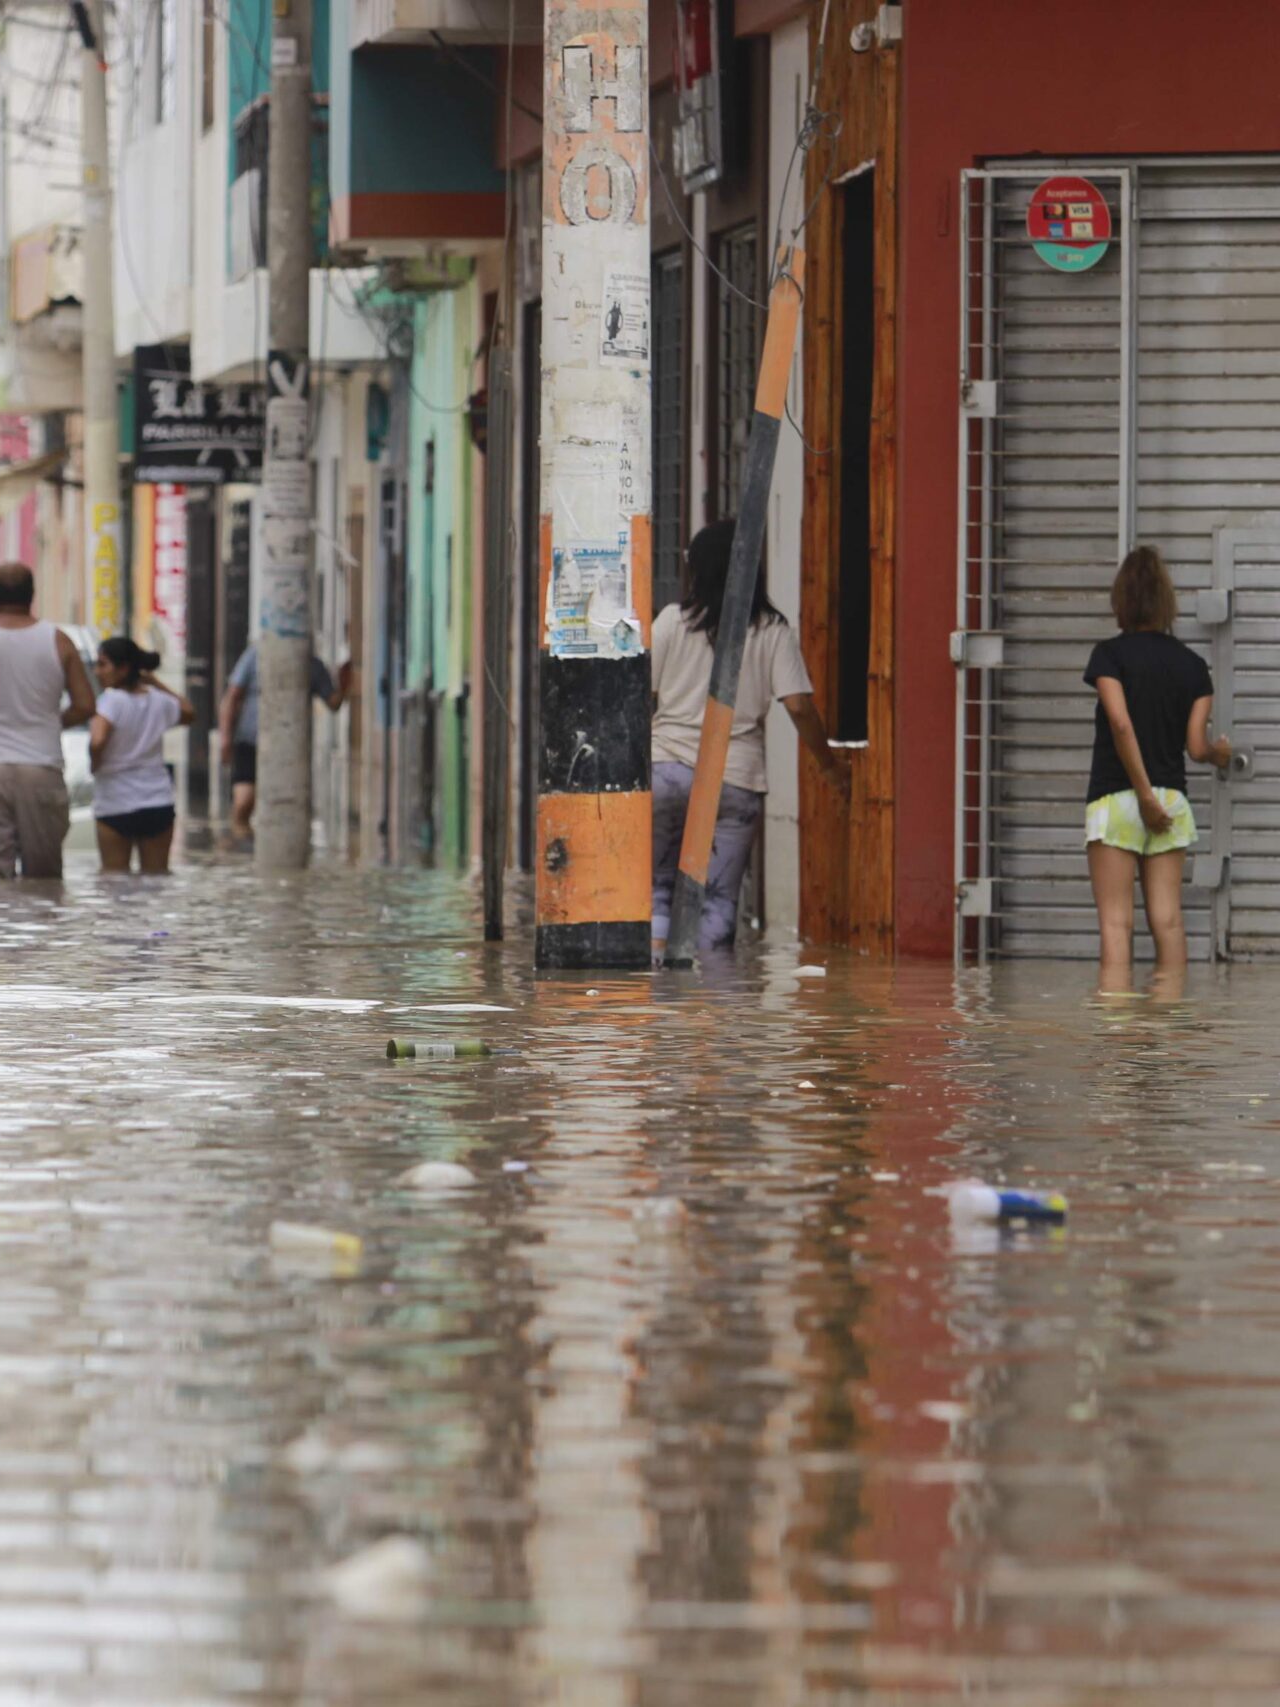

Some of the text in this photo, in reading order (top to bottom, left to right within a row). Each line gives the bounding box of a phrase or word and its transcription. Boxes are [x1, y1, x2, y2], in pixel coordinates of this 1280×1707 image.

[1046, 188, 1088, 199] Aceptamos
[1071, 206, 1090, 214] VISA
[93, 502, 119, 641] PARR
